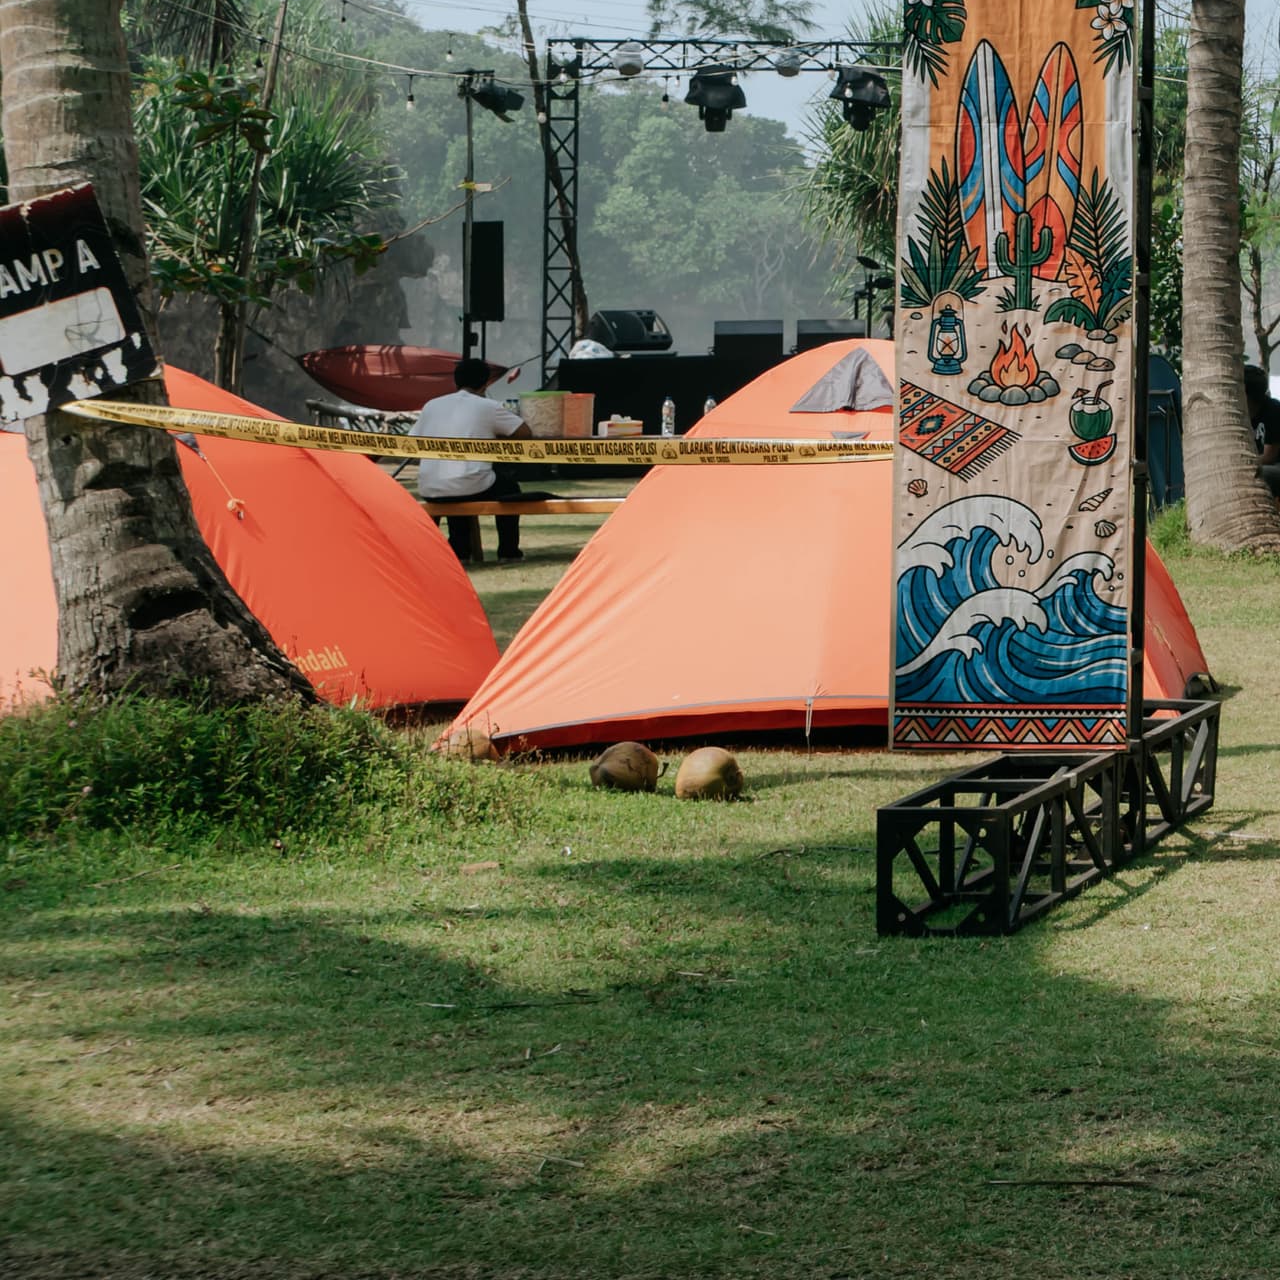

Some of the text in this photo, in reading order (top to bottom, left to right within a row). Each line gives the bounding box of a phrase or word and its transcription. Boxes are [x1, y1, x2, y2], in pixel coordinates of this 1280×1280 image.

[76, 239, 101, 273] A
[377, 436, 398, 449] POLISI
[502, 442, 525, 455] POLISI
[544, 442, 579, 455] DILARANG
[635, 442, 657, 455] POLISI
[679, 441, 713, 455] DILARANG
[283, 642, 348, 674] ndaki
